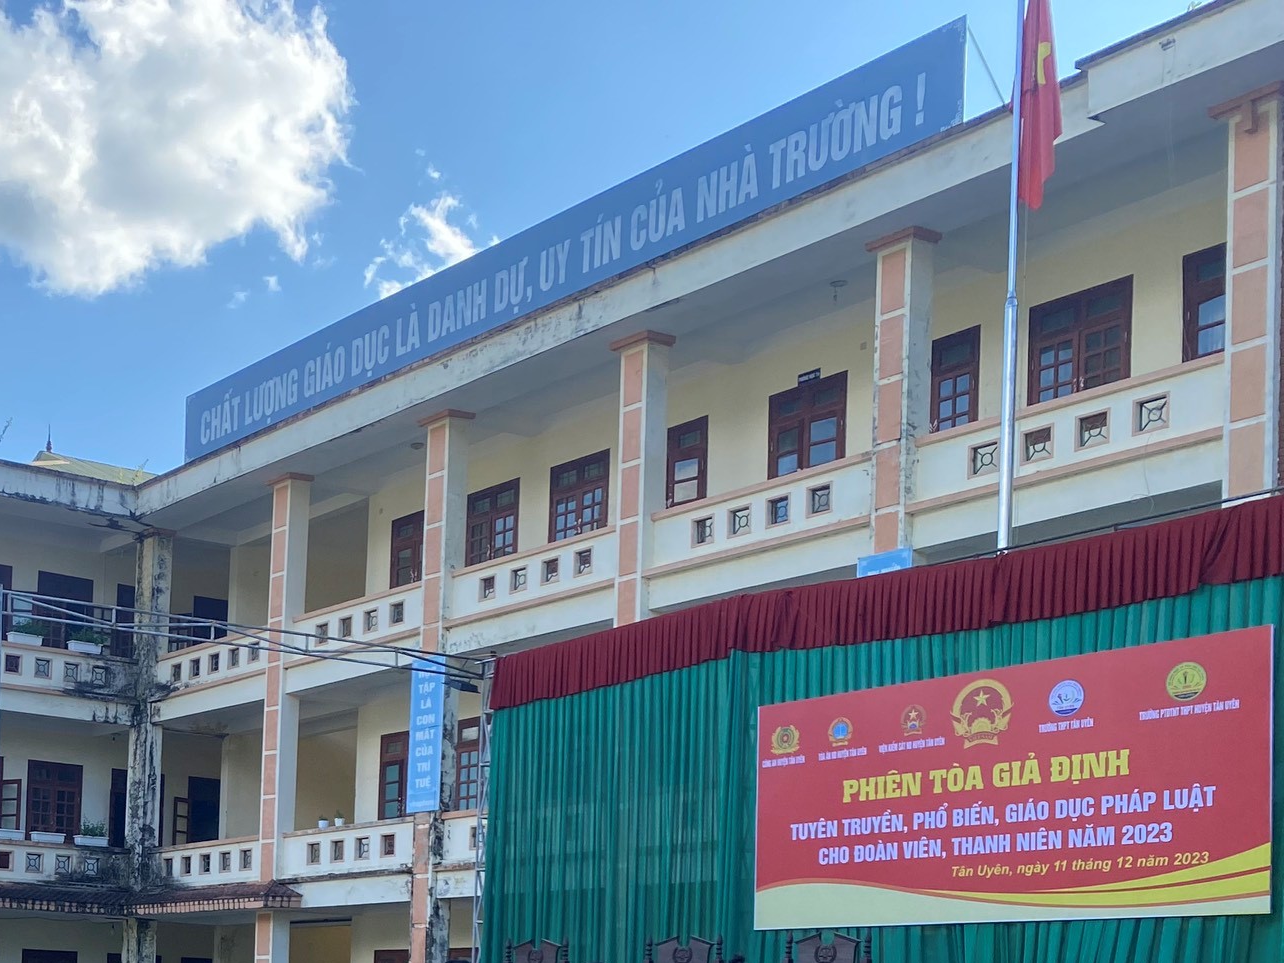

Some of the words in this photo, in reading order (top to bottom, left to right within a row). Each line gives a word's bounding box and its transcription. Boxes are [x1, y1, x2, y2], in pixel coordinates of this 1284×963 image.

[200, 390, 240, 445] CHẤT
[245, 368, 298, 423] LƯỢNG
[304, 341, 344, 398] GIÁO
[351, 324, 390, 377] DỤC
[396, 302, 420, 353] LÀ
[428, 278, 487, 342] DANH
[494, 256, 532, 314] DỰ,
[539, 239, 570, 291] UY
[580, 209, 621, 273] TÍN
[630, 179, 685, 250] CỦA
[696, 144, 758, 222] NHÀ
[769, 84, 903, 190] TRƯỜNG
[916, 73, 926, 126] !
[416, 714, 435, 725] CON
[842, 770, 922, 802] PHIÊN
[930, 763, 984, 794] TÒA
[992, 752, 1041, 788] GIẢ
[1050, 749, 1130, 784] ĐỊNH
[790, 818, 838, 840] TUYÊN
[842, 810, 908, 836] TRUYỀN,
[913, 802, 948, 830] PHỔ
[952, 801, 999, 826] BIẾN,
[1006, 798, 1048, 822] GIÁO
[1056, 798, 1094, 821] DỤC
[1101, 789, 1156, 815] PHÁP
[1164, 783, 1216, 812] LUẬT
[818, 847, 849, 865] CHO
[854, 840, 898, 862] ĐOÀN
[903, 836, 946, 859] VIÊN,
[952, 834, 1010, 855] THANH
[1016, 828, 1062, 851] NIÊN
[1068, 824, 1114, 848] NĂM
[1122, 822, 1172, 844] 2023
[951, 864, 973, 877] Tân
[978, 864, 1012, 878] Uyên,
[1017, 861, 1049, 876] ngày
[1054, 860, 1067, 872] 11
[1072, 858, 1111, 872] tháng
[1117, 856, 1132, 868] 12
[1138, 855, 1168, 866] năm
[1174, 852, 1209, 864] 2023
